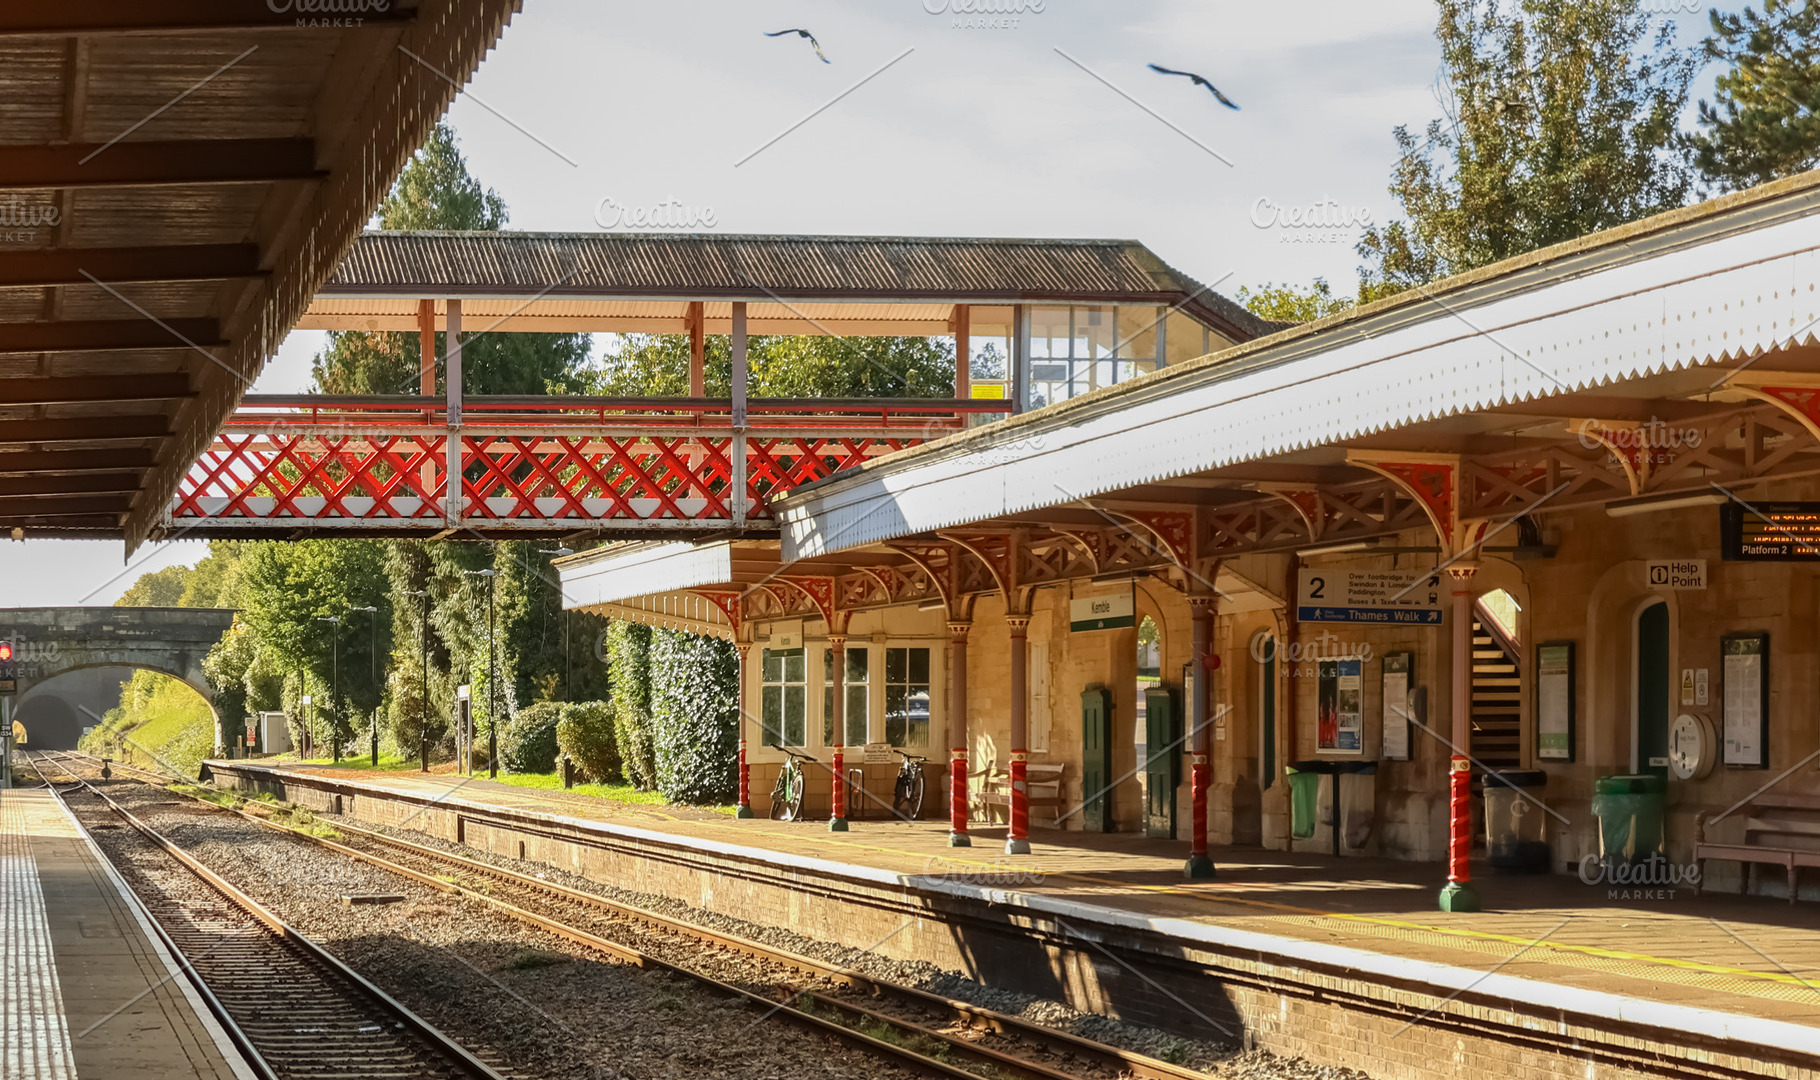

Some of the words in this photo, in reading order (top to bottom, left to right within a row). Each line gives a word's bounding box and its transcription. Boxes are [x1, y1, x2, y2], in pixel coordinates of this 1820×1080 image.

[1742, 545, 1779, 554] Platform
[1781, 545, 1788, 554] 2
[1671, 562, 1698, 575] Help
[1368, 573, 1403, 582] footbridge
[1671, 576, 1702, 587] Point
[1309, 577, 1325, 599] 2
[1348, 589, 1386, 597] Paddington
[1348, 610, 1389, 621] Thames
[1394, 611, 1420, 622] Walk
